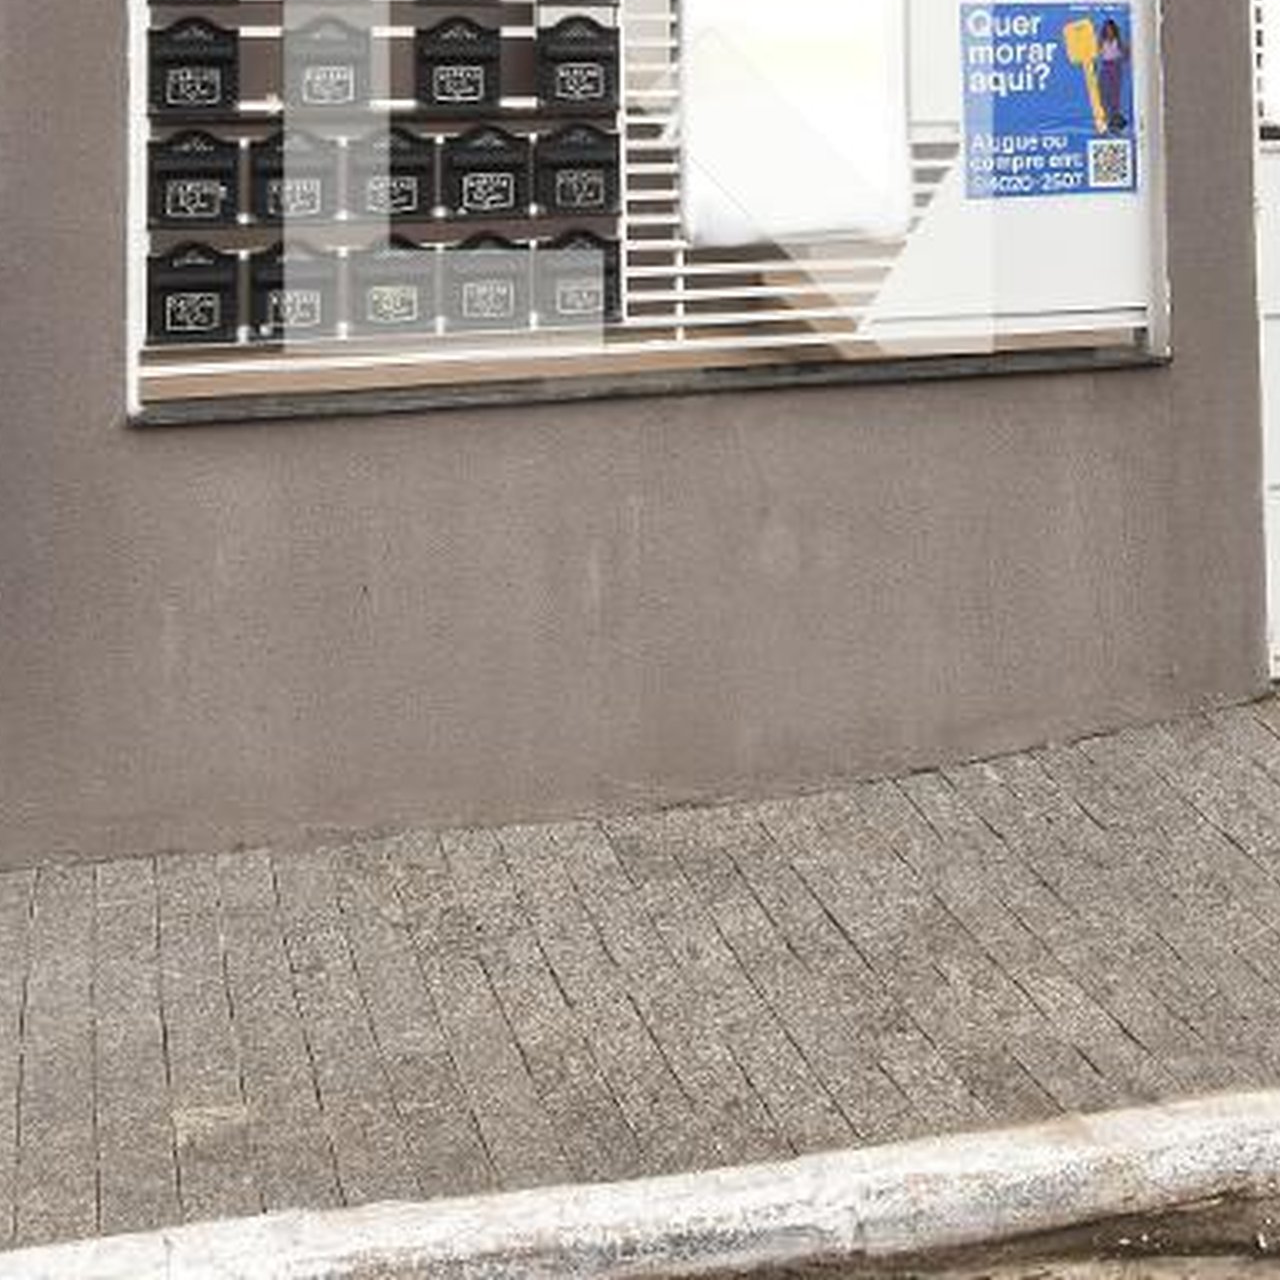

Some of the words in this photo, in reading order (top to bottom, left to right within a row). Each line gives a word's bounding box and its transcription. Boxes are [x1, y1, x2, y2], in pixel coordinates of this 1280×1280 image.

[967, 9, 1042, 38] Quer
[969, 42, 1058, 65] morar
[969, 63, 1051, 98] aqui?
